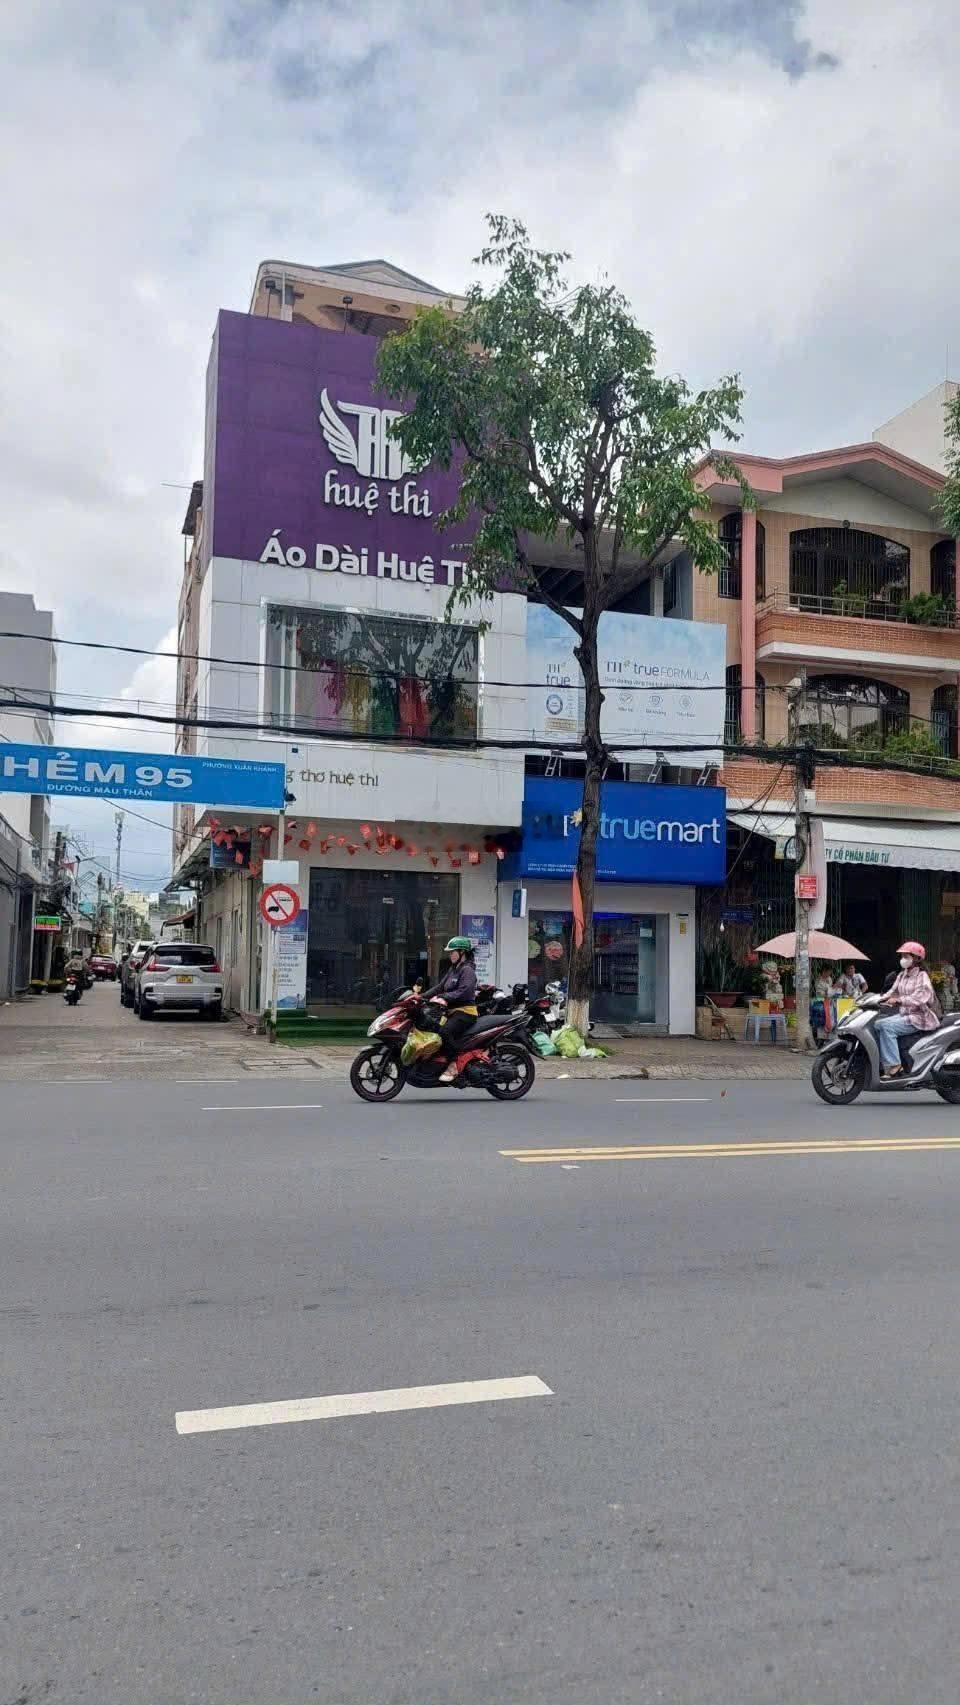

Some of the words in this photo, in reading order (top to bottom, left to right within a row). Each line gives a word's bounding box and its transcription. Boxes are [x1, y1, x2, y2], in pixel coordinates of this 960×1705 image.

[324, 469, 379, 516] huệ
[387, 481, 433, 517] thi
[259, 529, 307, 568] Áo
[315, 543, 369, 576] Dài
[377, 551, 435, 592] Huệ
[546, 673, 571, 687] true
[4, 752, 125, 784] HẺM
[135, 766, 192, 788] 95
[300, 769, 325, 783] thơ
[329, 771, 355, 786] huệ
[600, 812, 721, 844] truemart
